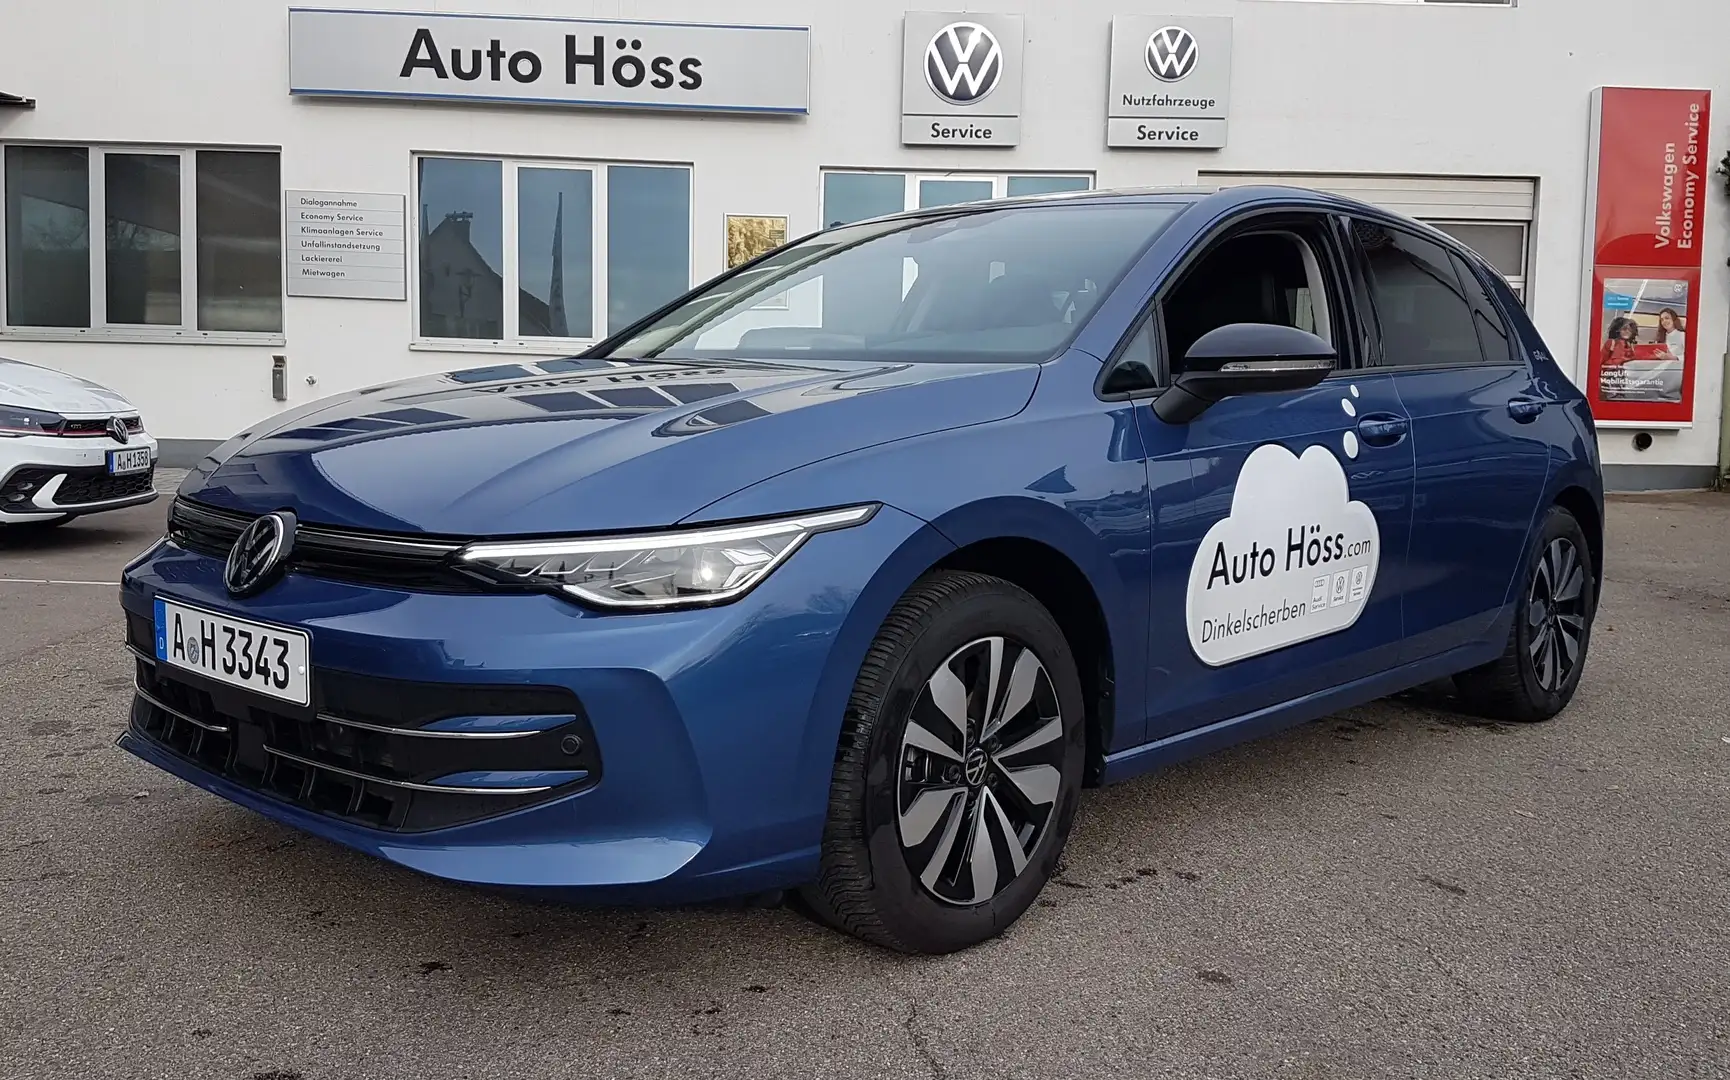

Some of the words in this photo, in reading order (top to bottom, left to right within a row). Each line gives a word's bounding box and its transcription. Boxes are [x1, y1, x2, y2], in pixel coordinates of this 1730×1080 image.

[400, 28, 542, 83] Auto
[564, 34, 703, 90] Höss
[1122, 94, 1215, 109] Nutzfahrzeuge
[930, 123, 992, 140] Service
[1137, 125, 1199, 142] Service
[1682, 103, 1700, 165] Service
[300, 197, 358, 208] Dialogannahme
[1654, 142, 1677, 248] Volkswagen
[301, 212, 334, 222] Economy
[337, 213, 364, 222] Service
[1677, 170, 1700, 249] Economy
[301, 226, 354, 237] Klimaanlagen
[356, 228, 383, 237] Service
[301, 240, 381, 252] Unfallinstandsetzung
[301, 254, 343, 263] Lackiererei
[302, 268, 345, 279] Mietwagen
[1206, 541, 1276, 590] Auto
[1285, 524, 1371, 572] Höss.com
[1201, 599, 1306, 644] Dinkelscherben
